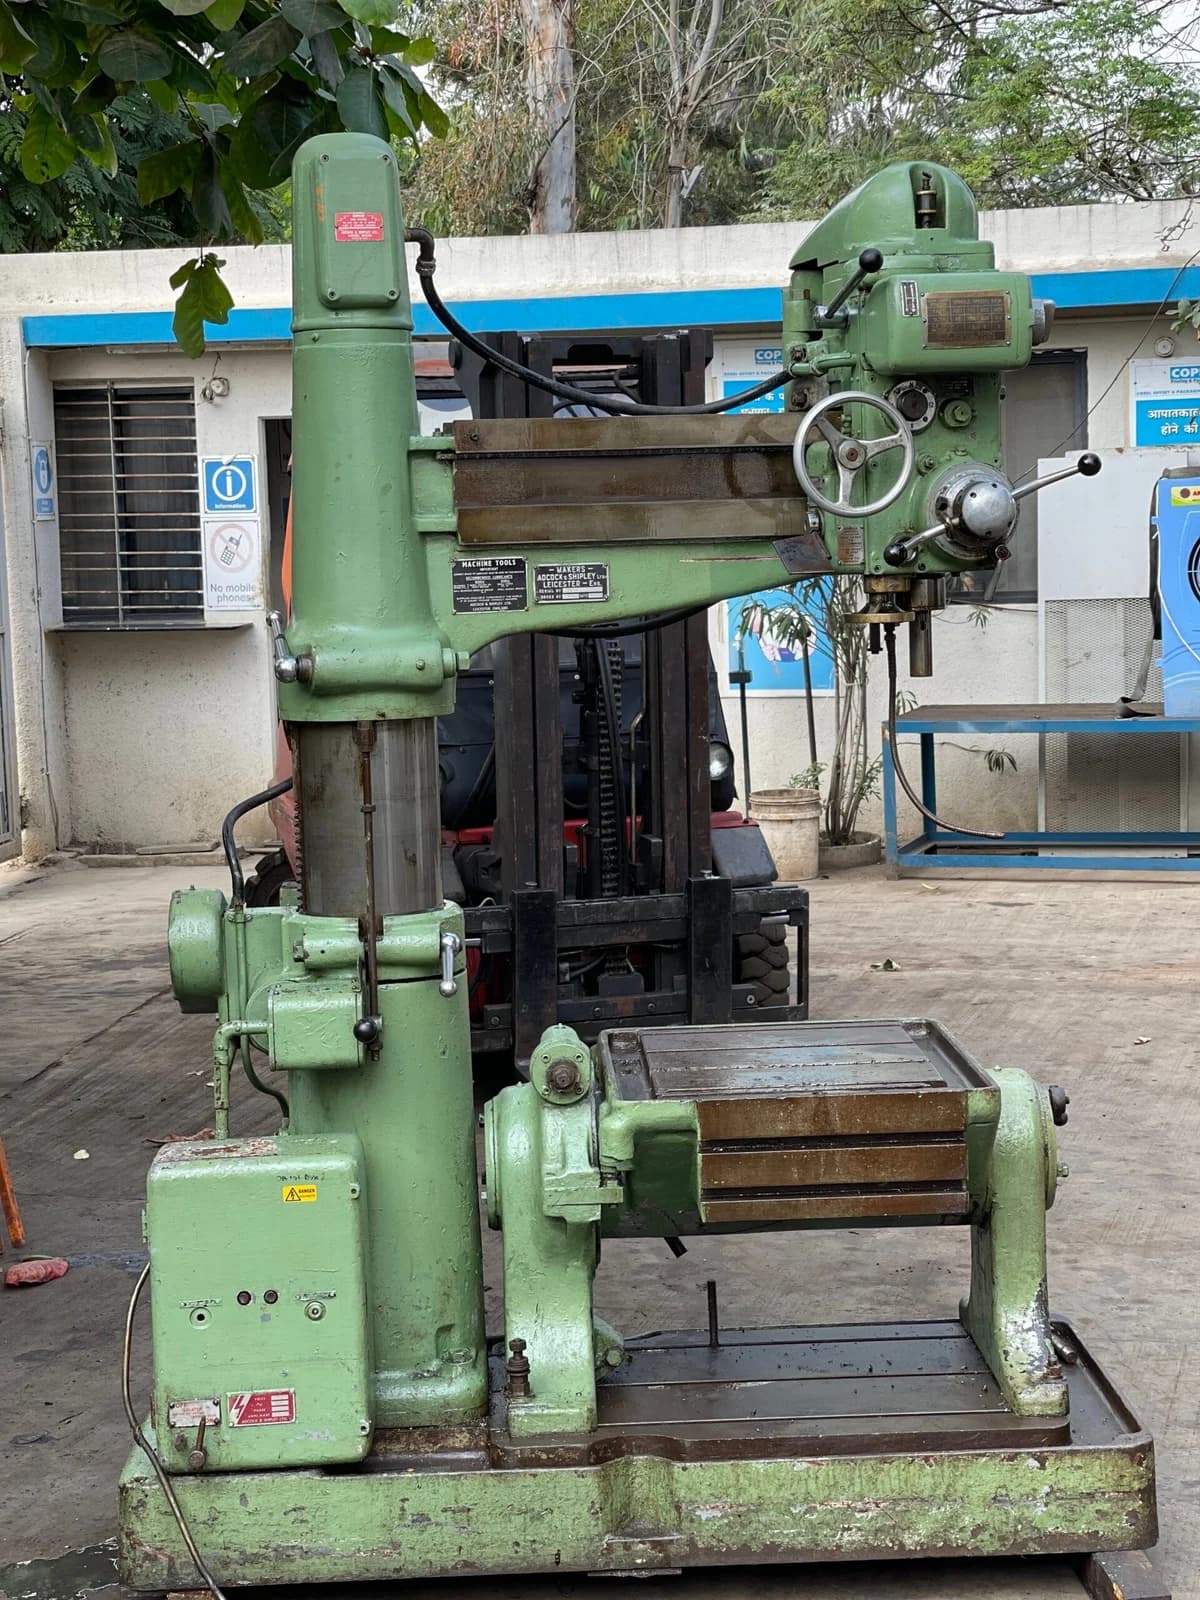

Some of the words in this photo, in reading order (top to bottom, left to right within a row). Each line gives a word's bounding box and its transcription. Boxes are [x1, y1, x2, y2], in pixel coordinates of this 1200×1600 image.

[1172, 367, 1200, 378] COP
[462, 560, 492, 568] MACHINE
[556, 565, 586, 573] MAKERS
[537, 573, 564, 581] ADCOCK
[568, 572, 596, 580] SHIPLEY
[211, 584, 223, 592] No
[226, 584, 256, 592] mobile
[543, 580, 580, 588] LEICESTER
